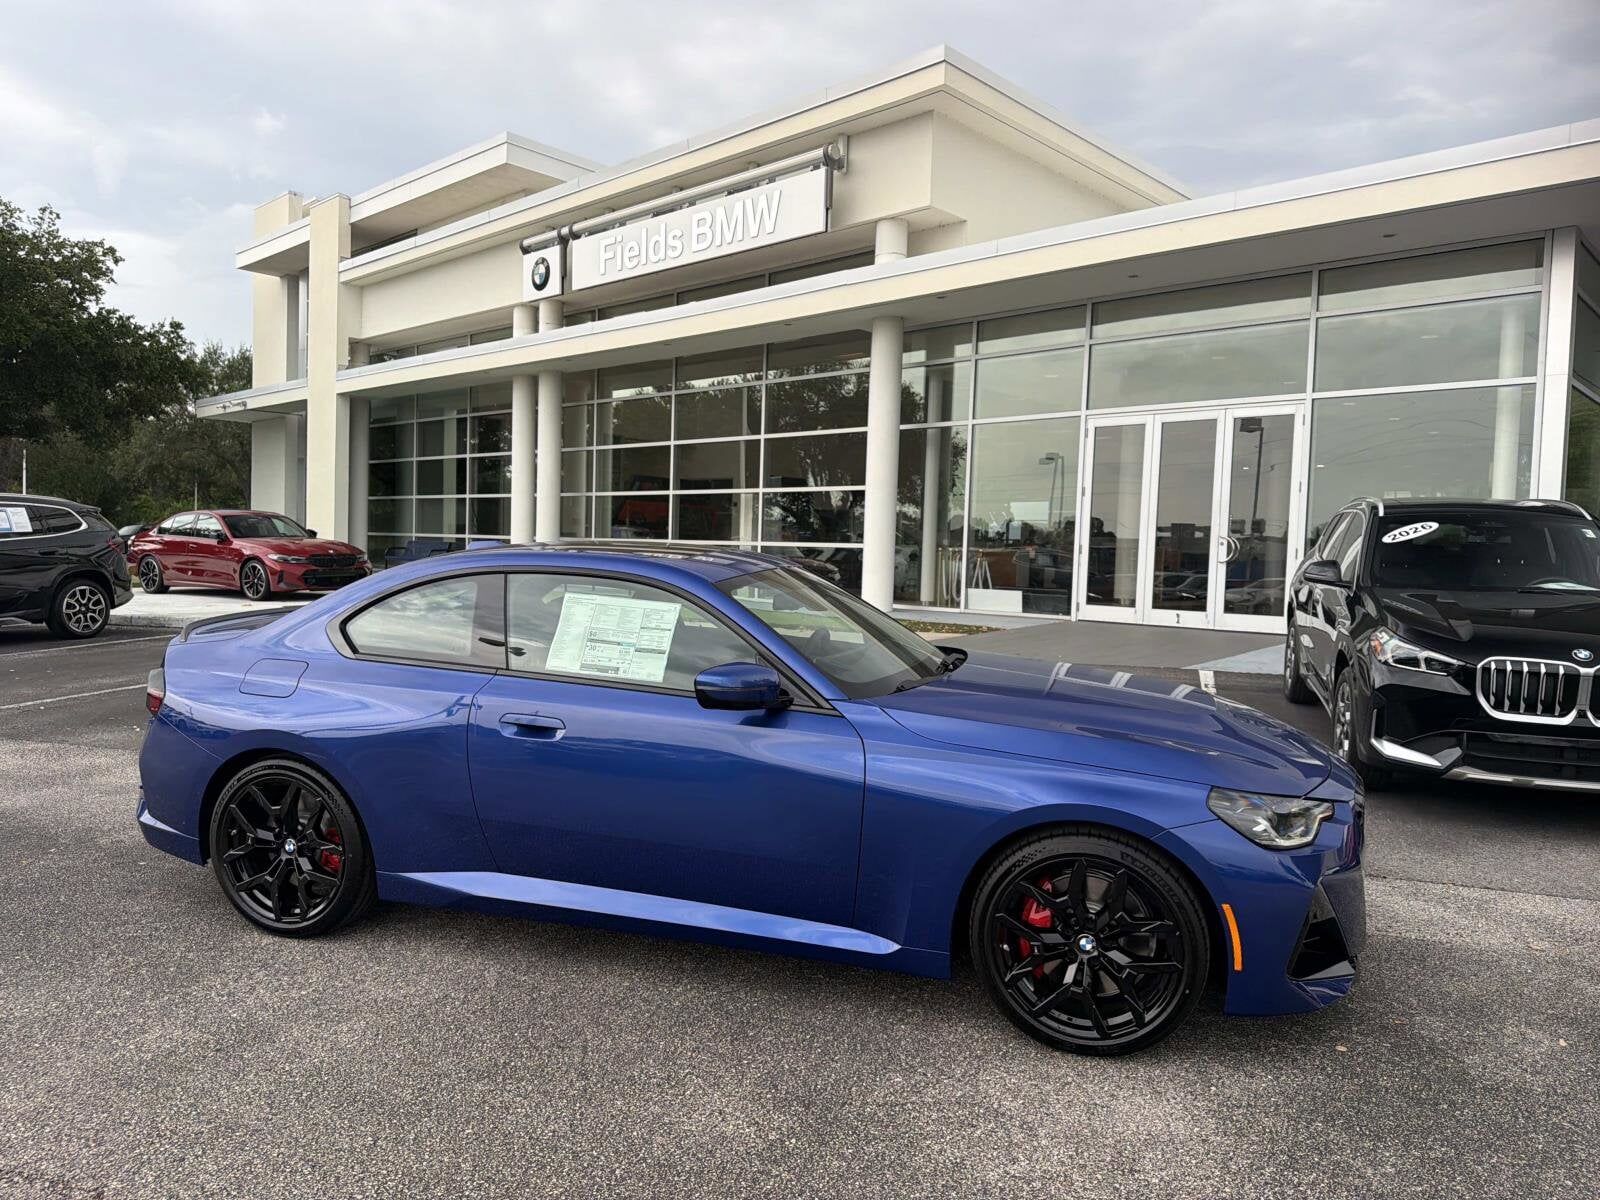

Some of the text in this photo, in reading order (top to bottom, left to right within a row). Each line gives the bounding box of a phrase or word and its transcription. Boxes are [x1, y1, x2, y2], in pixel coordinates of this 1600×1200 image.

[599, 189, 782, 276] Fields BMW
[1387, 523, 1433, 541] 2026
